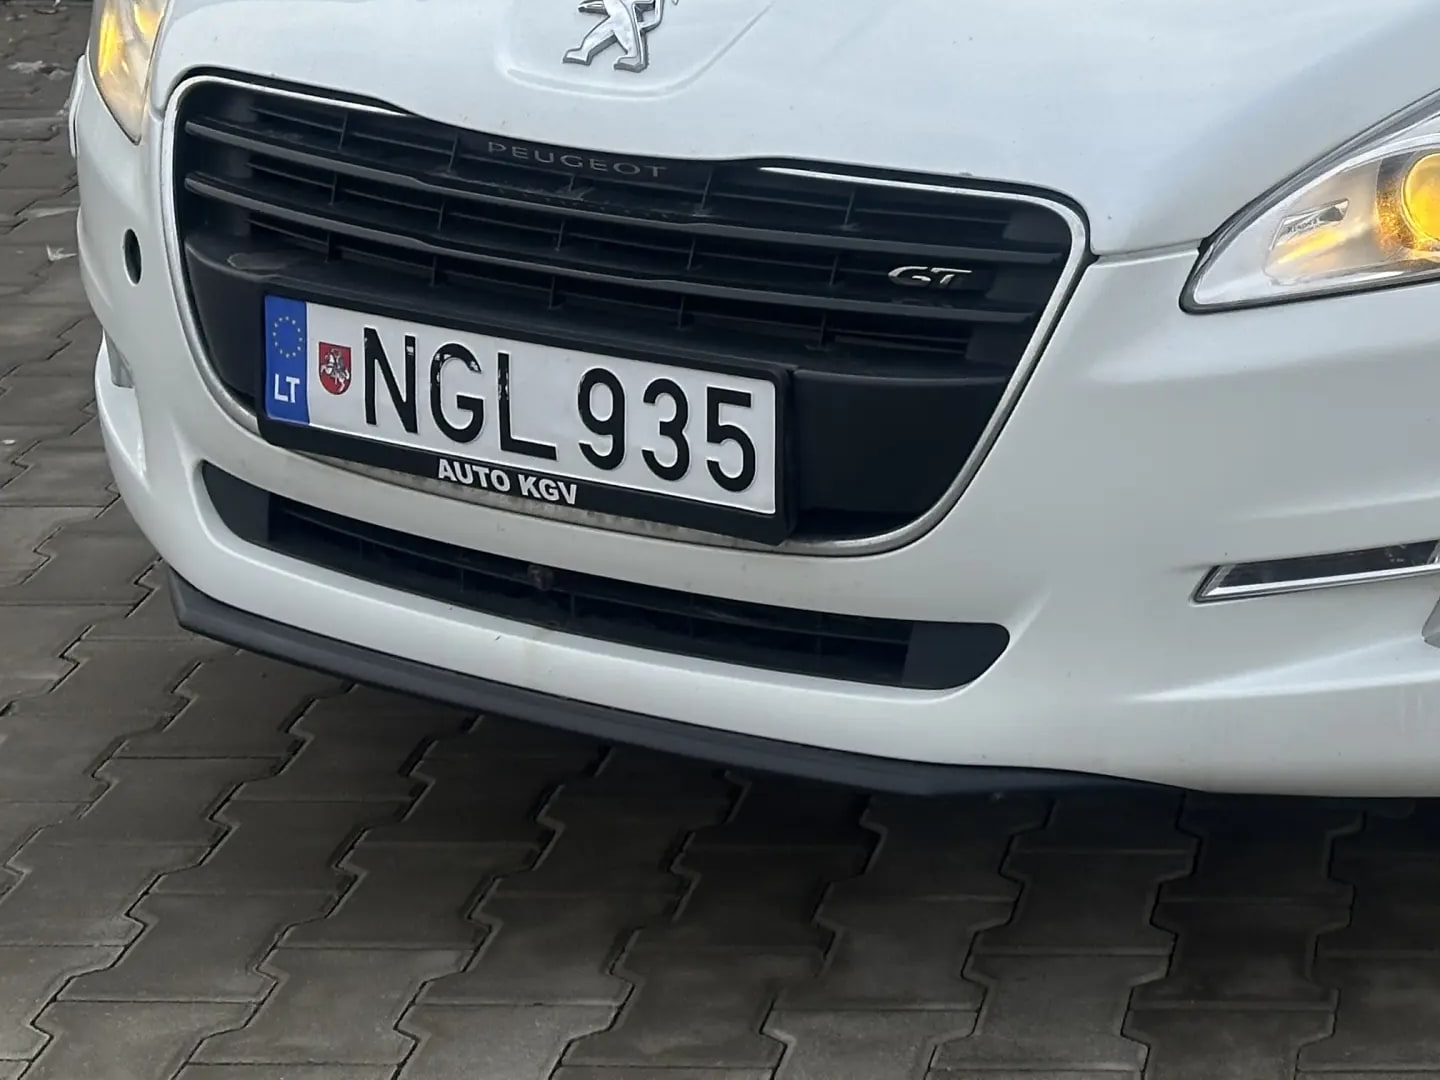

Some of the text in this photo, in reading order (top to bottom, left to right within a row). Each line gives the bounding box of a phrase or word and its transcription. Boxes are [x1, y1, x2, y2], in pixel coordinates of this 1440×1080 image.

[488, 141, 667, 177] PEUGEOT
[888, 266, 972, 288] GT
[274, 372, 300, 404] LT
[364, 327, 757, 493] NGL 935
[437, 458, 578, 506] AUTO KGV
